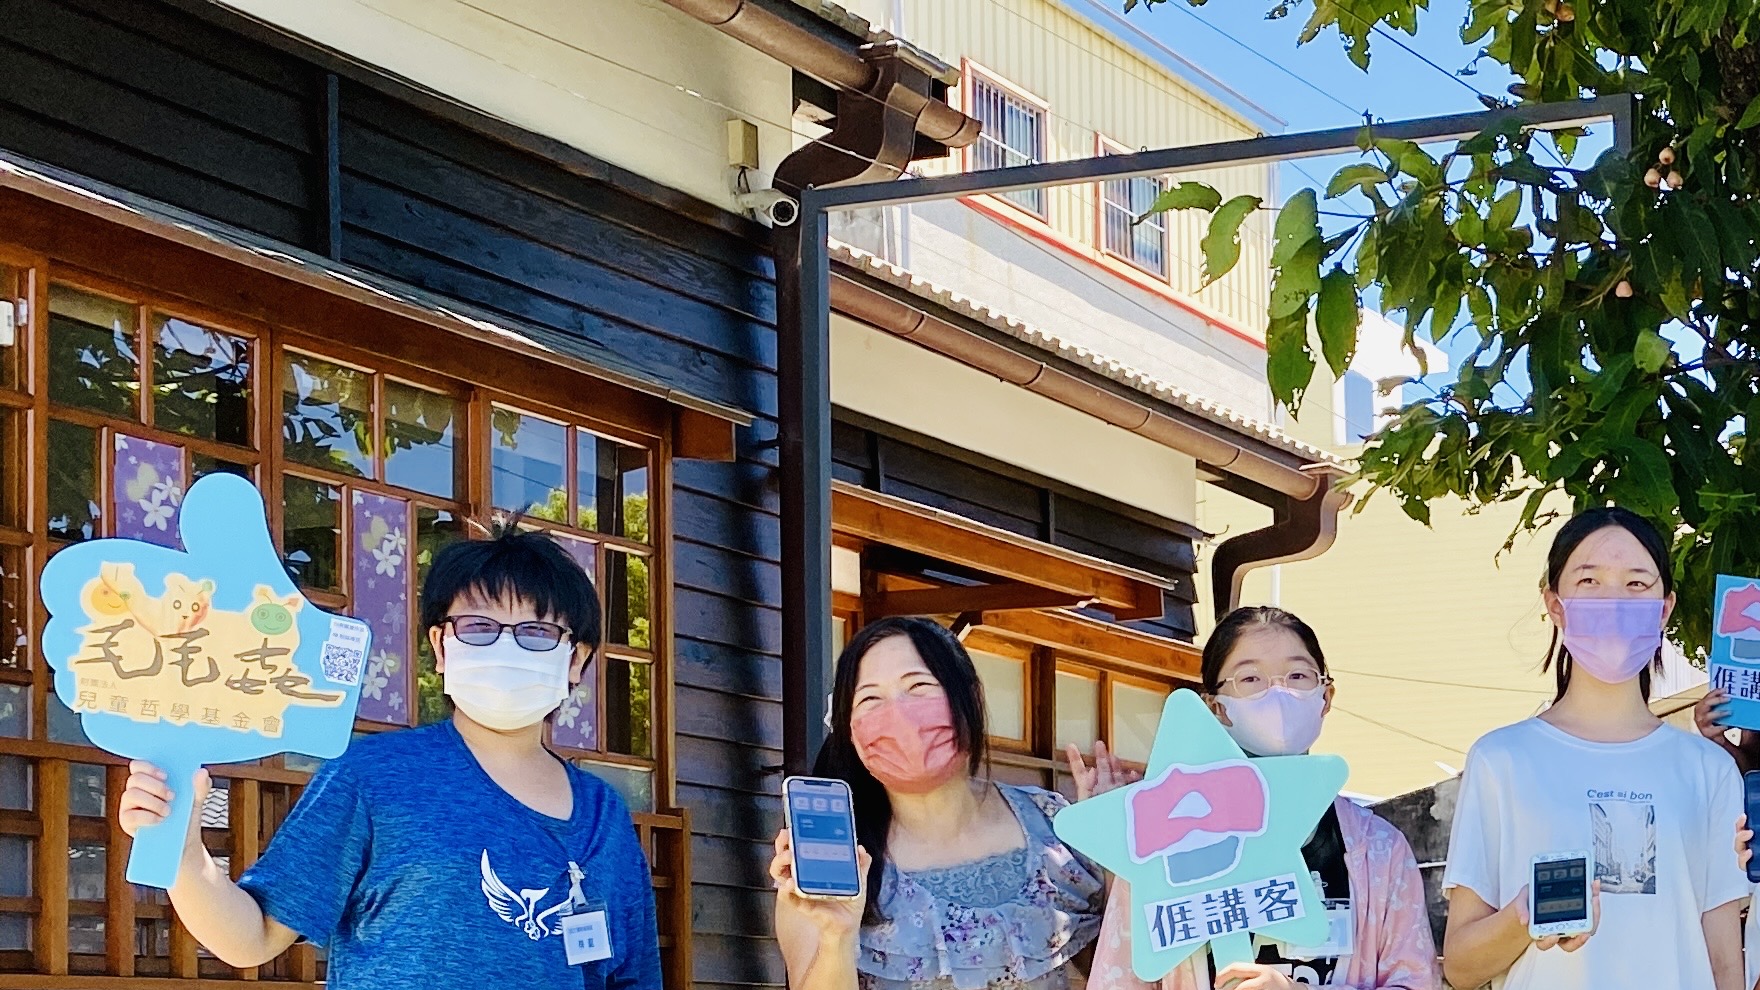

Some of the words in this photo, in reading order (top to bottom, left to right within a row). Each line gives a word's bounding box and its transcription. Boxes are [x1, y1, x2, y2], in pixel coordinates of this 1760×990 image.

[79, 690, 281, 733] 兒童哲學基金會
[1630, 791, 1653, 800] bon
